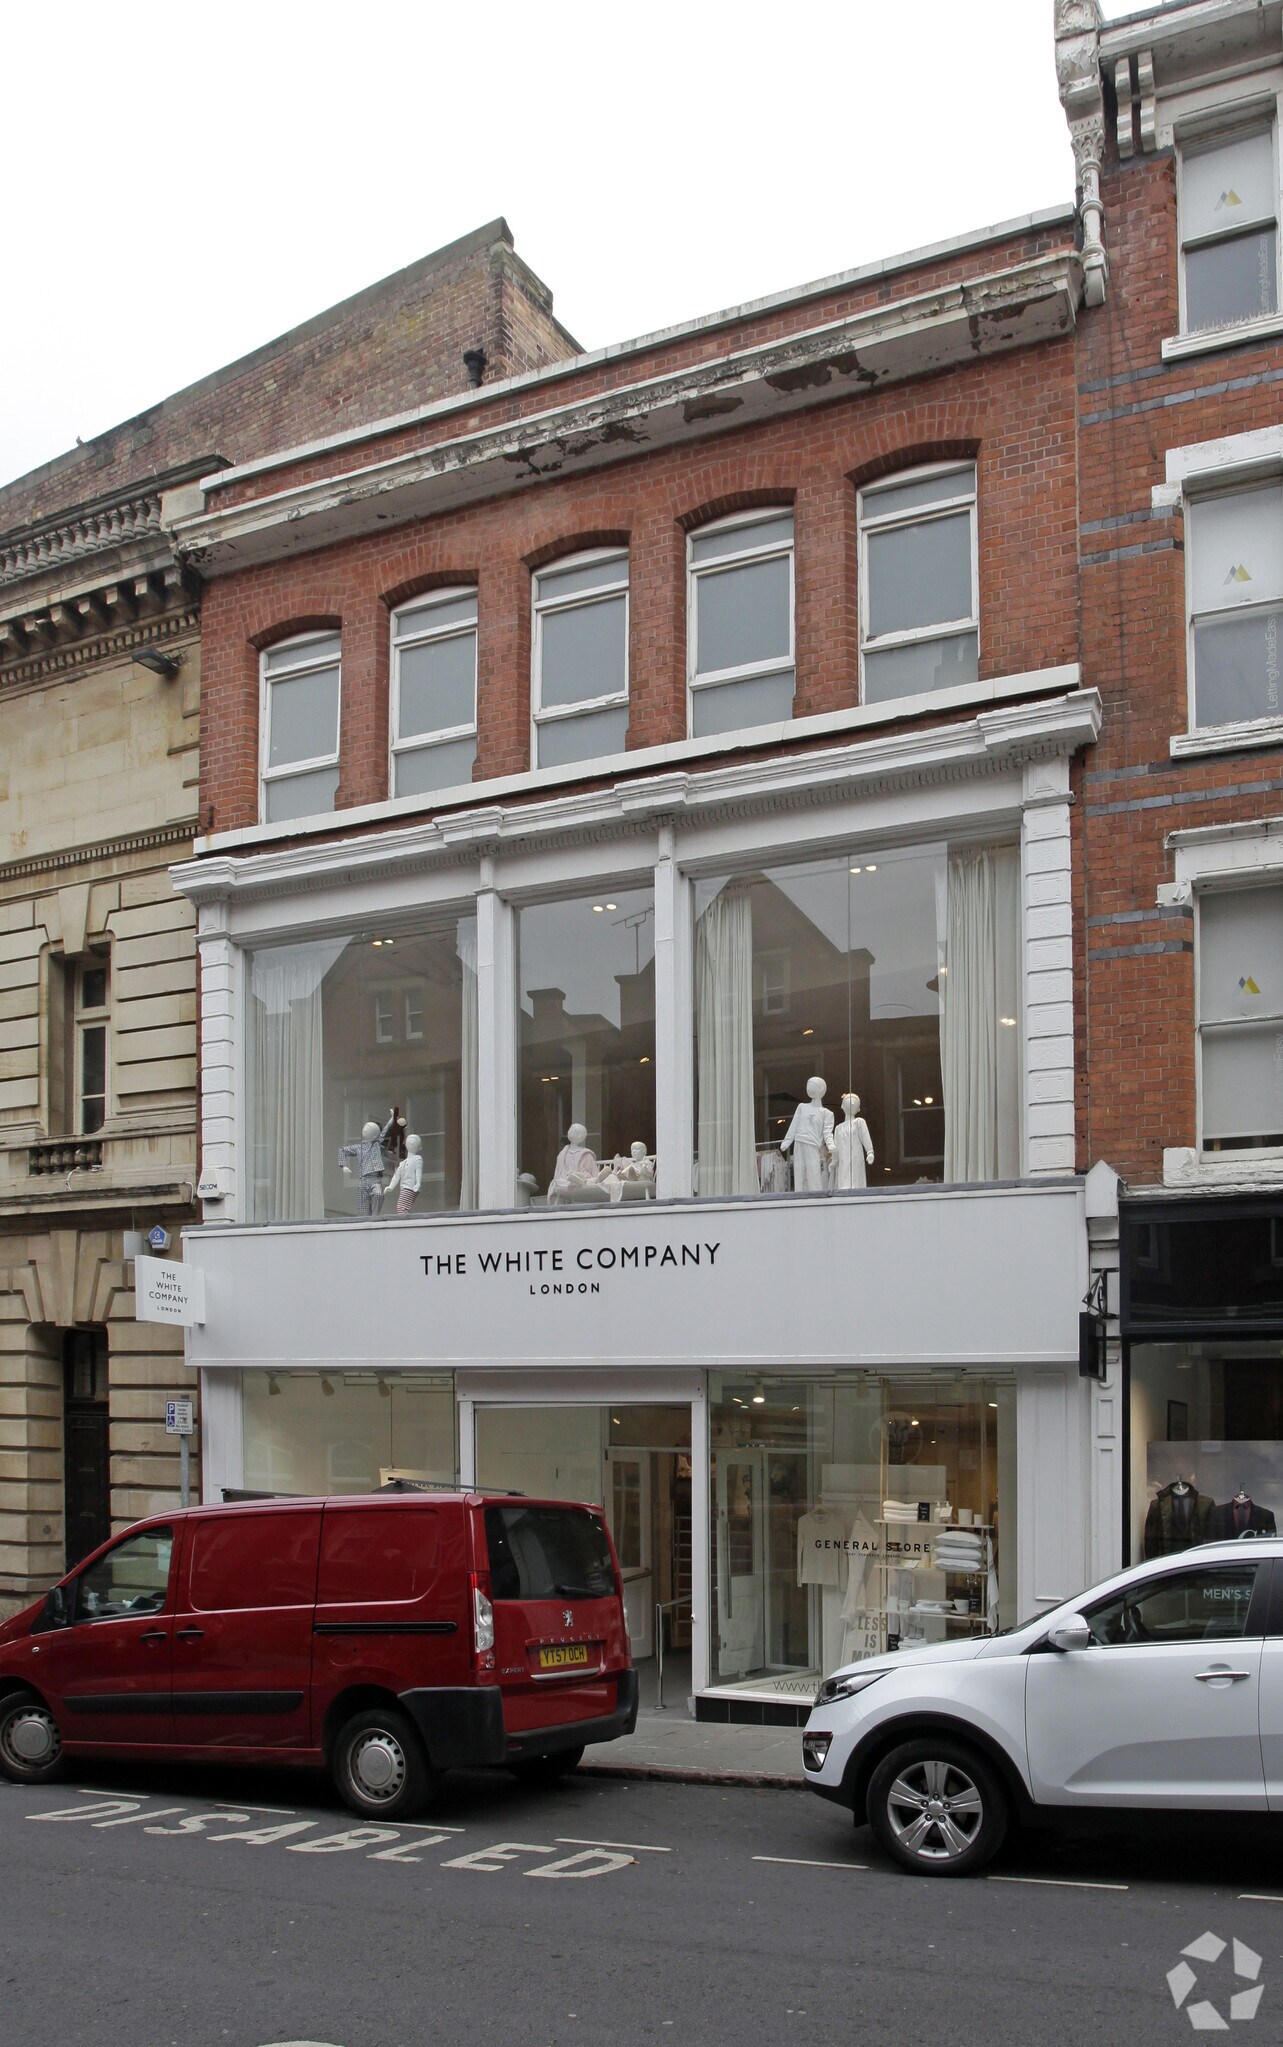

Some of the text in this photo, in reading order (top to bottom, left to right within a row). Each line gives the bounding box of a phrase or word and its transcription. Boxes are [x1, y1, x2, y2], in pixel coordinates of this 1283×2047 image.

[1264, 614, 1280, 710] LettingMadeEas
[199, 1183, 218, 1191] SECOM
[420, 1243, 721, 1275] THE WHITE COMPANY
[161, 1271, 176, 1281] THE
[156, 1281, 182, 1293] WHITE
[530, 1282, 600, 1295] LONDON
[148, 1291, 189, 1304] COMPANY
[156, 1305, 182, 1313] LONDON
[168, 1403, 175, 1414] P
[815, 1540, 931, 1552] GENERAL STORE
[1203, 1588, 1241, 1600] MEN'S
[857, 1615, 887, 1632] LESS
[540, 1634, 600, 1644] PEUGEOT
[864, 1633, 877, 1648] IS
[543, 1649, 567, 1664] YT57
[25, 1801, 636, 1879] DISABLED
